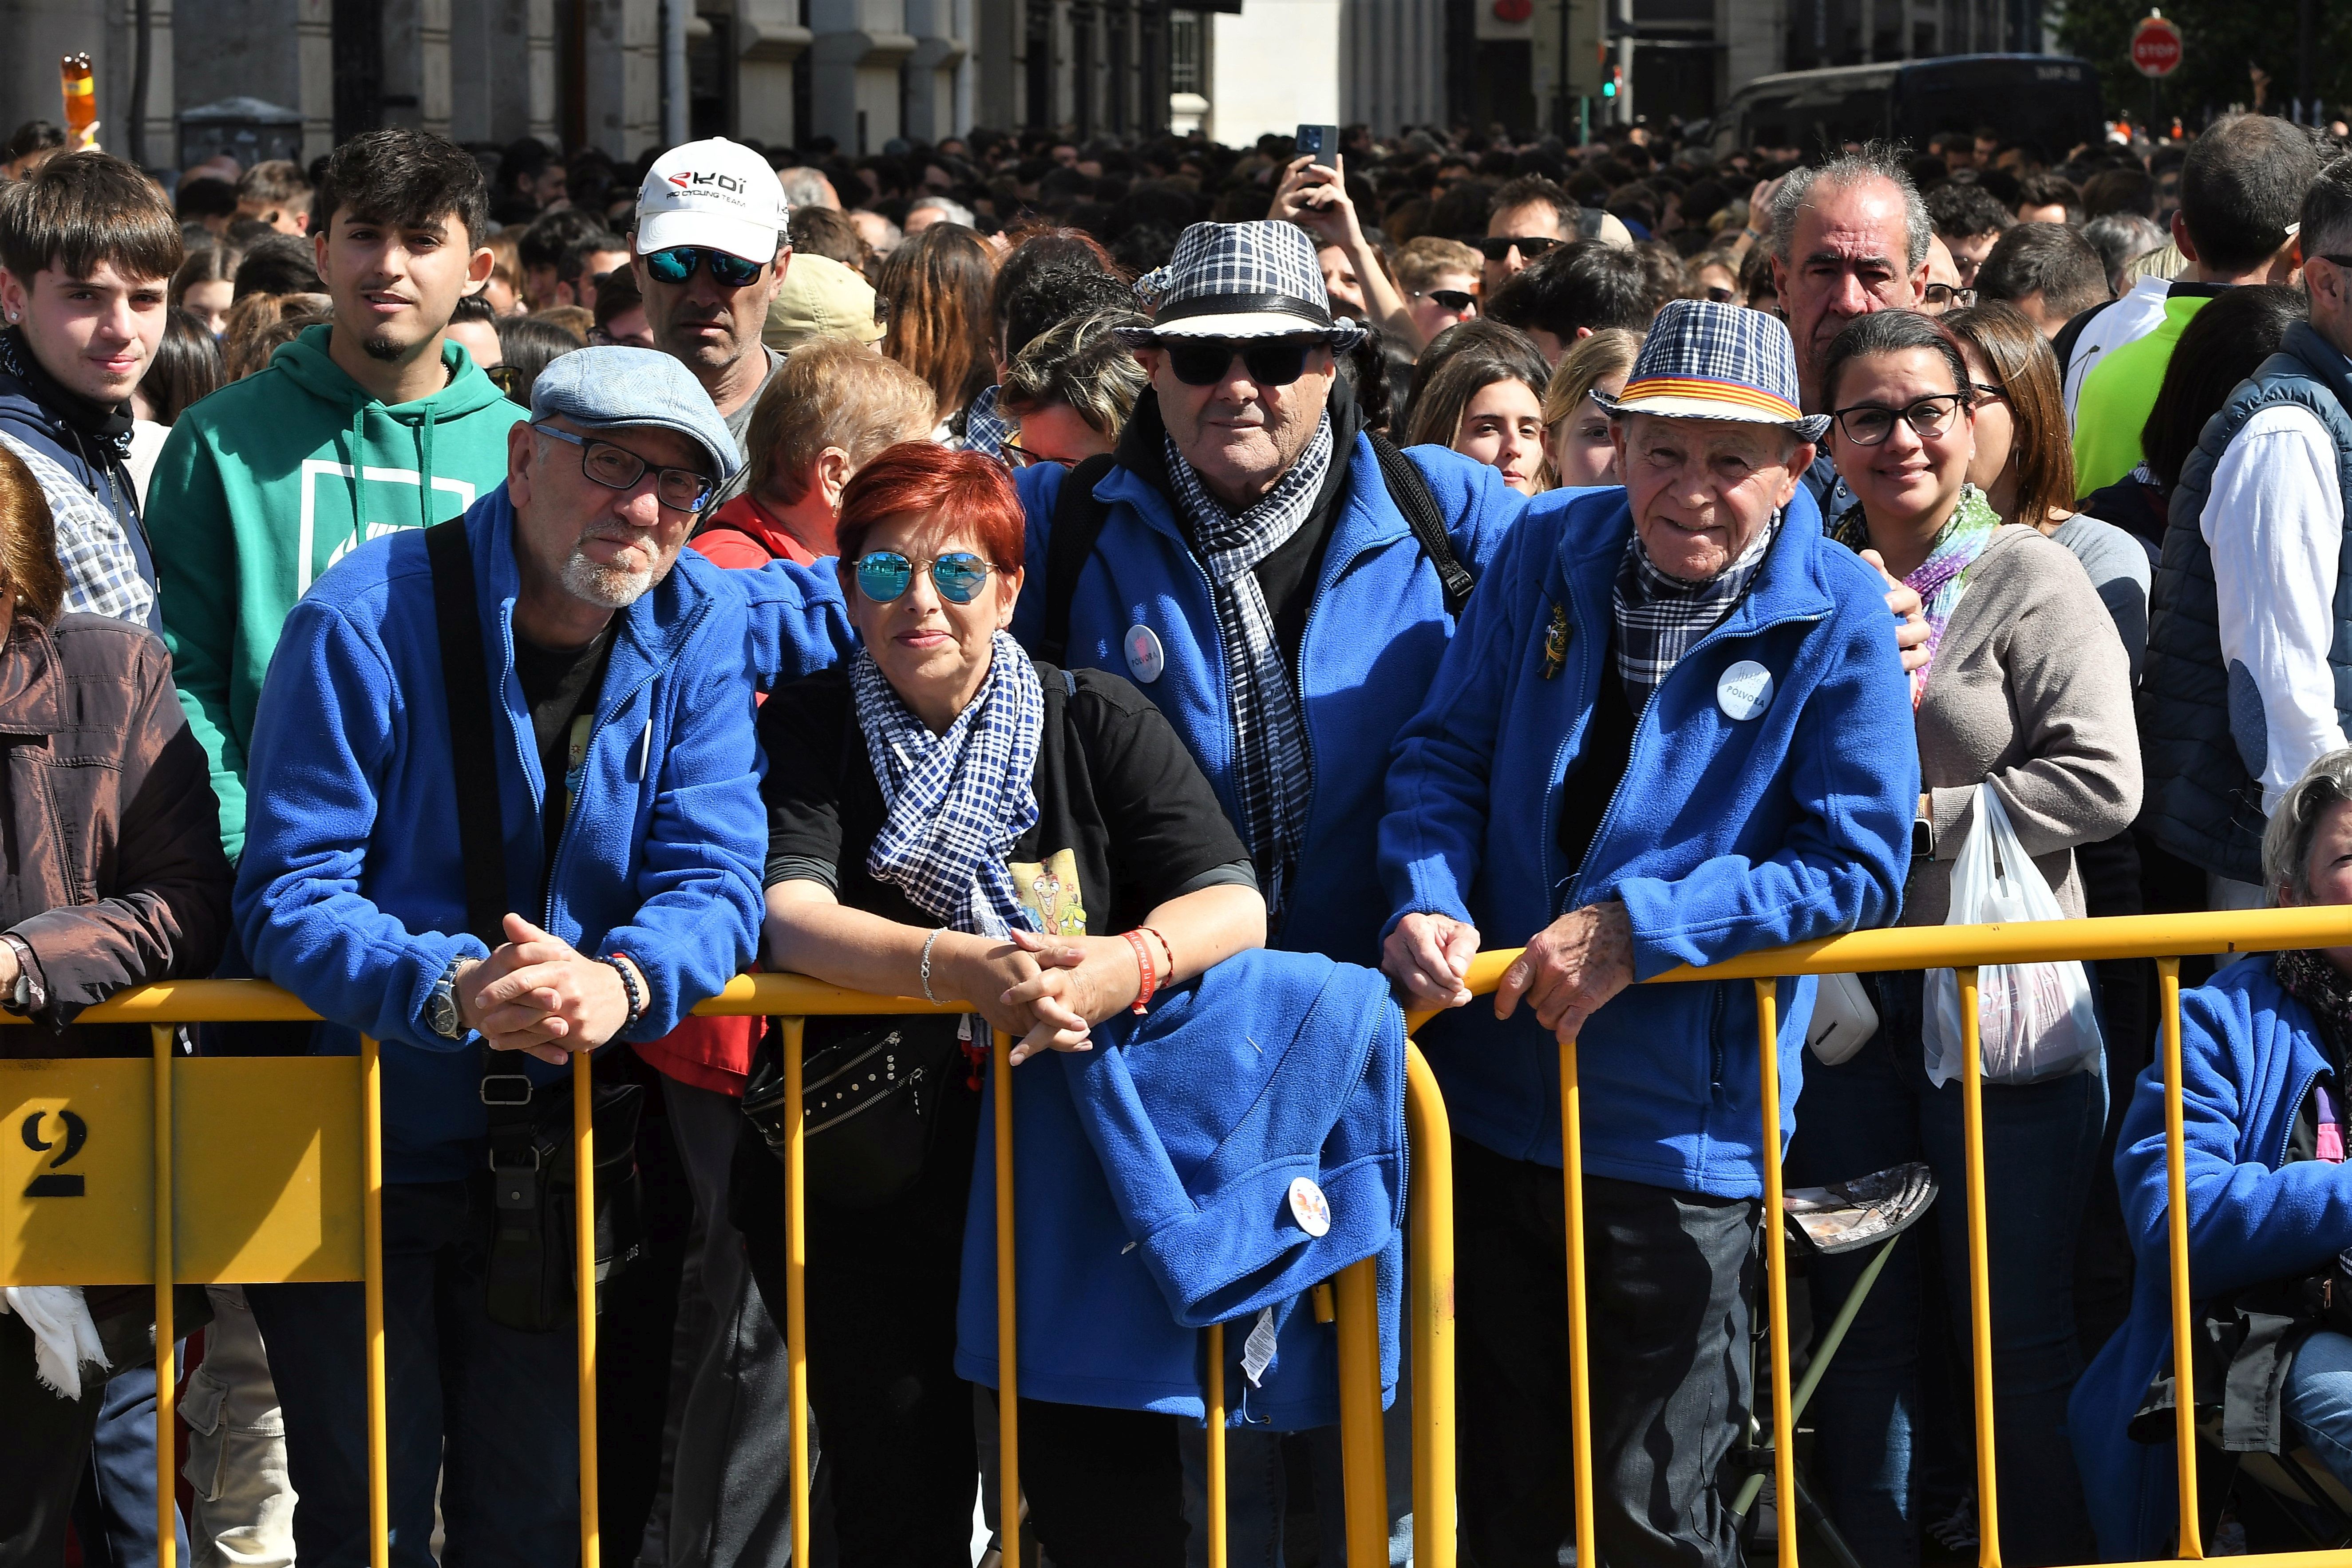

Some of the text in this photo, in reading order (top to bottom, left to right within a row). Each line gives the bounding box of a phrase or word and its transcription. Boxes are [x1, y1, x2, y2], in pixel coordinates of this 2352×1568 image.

[2137, 43, 2175, 58] STOP
[666, 190, 746, 208] PRO CYCLING TEAM
[1727, 685, 1765, 708] PÓLVORA
[21, 1110, 87, 1197] 2
